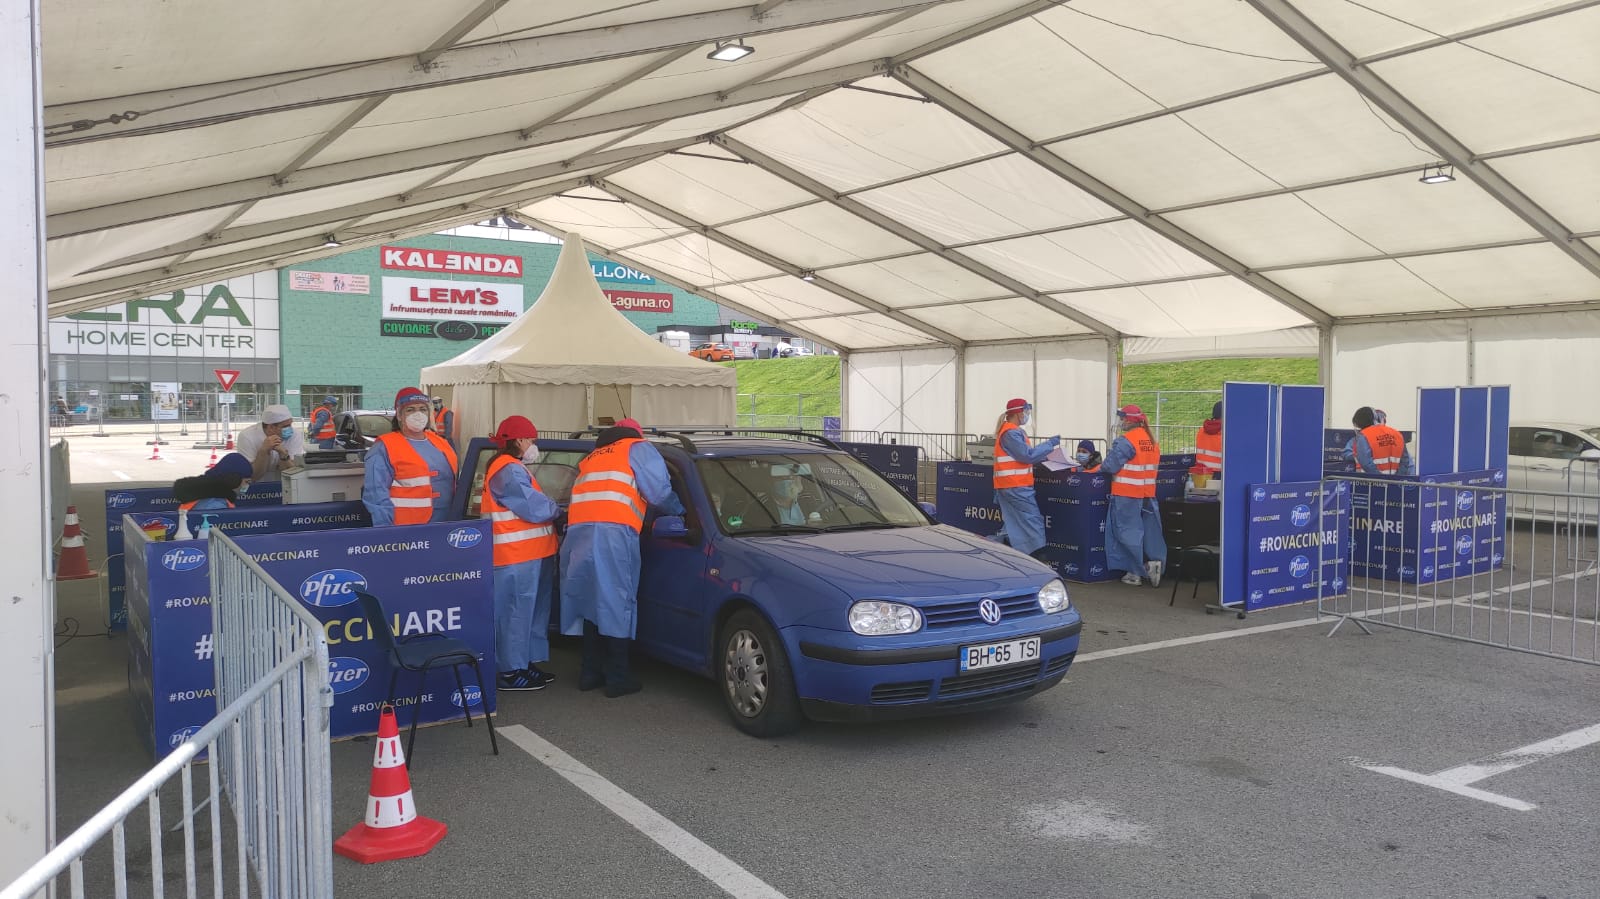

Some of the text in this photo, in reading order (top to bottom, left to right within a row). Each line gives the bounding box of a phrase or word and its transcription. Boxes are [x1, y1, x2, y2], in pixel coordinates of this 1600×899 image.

[454, 308, 478, 316] casele
[383, 322, 433, 335] COVOARE
[67, 330, 254, 349] HOME CENTER
[449, 530, 482, 548] Pfizer
[164, 550, 205, 570] Pfizer
[347, 540, 431, 556] #ROVACCINARE
[403, 570, 482, 585] #ROVACCINARE
[969, 639, 1039, 667] BH 65 TSI
